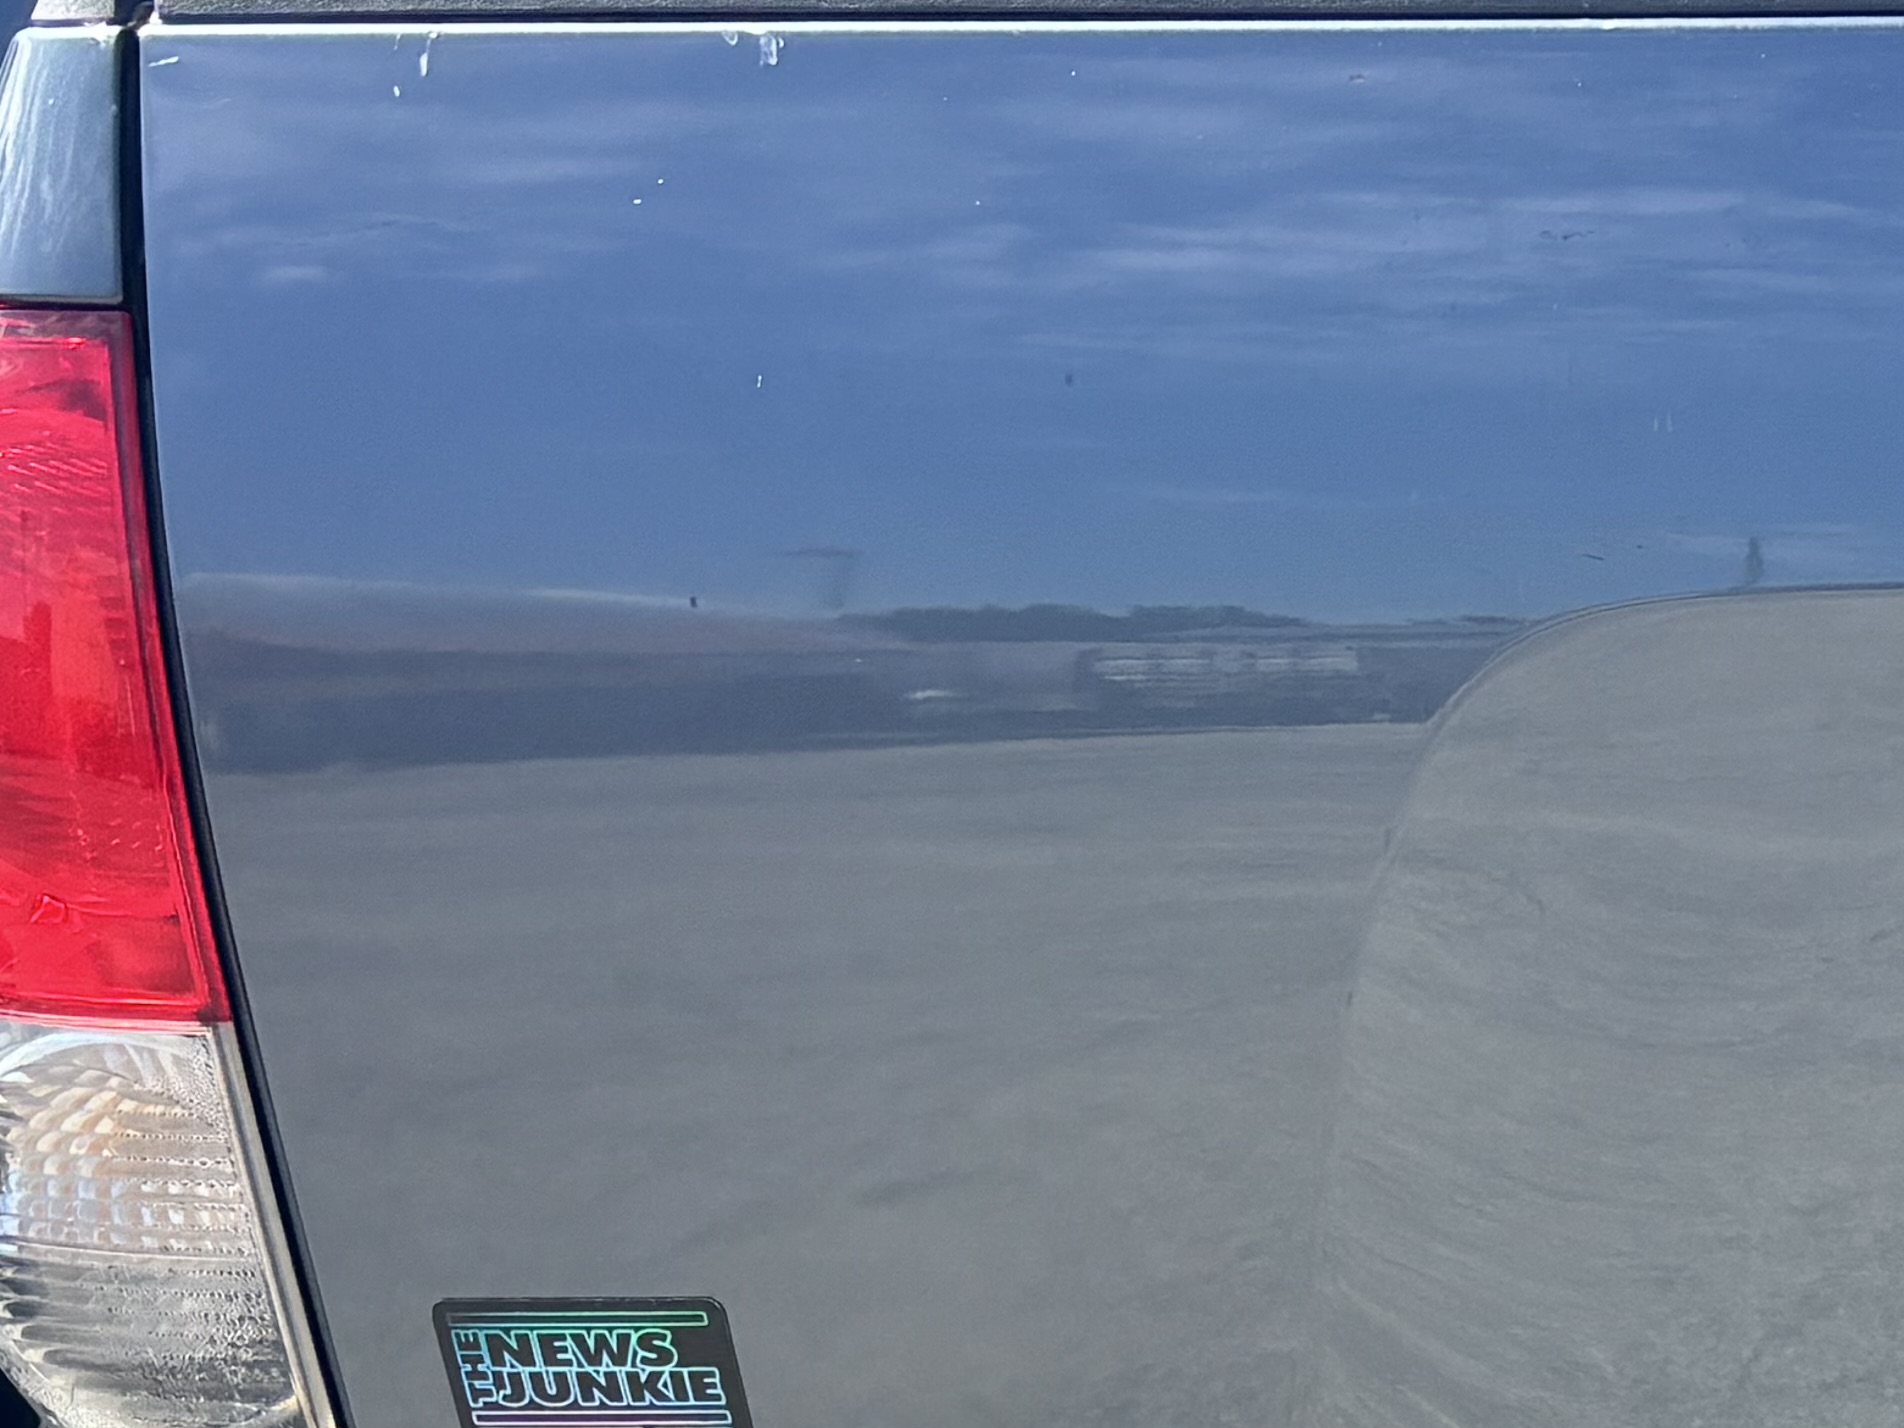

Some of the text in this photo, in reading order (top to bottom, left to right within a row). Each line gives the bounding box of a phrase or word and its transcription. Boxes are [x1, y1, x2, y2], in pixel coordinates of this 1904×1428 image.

[451, 1329, 498, 1407] THE
[482, 1329, 678, 1370] NEWS
[498, 1367, 727, 1407] JUNKIE
